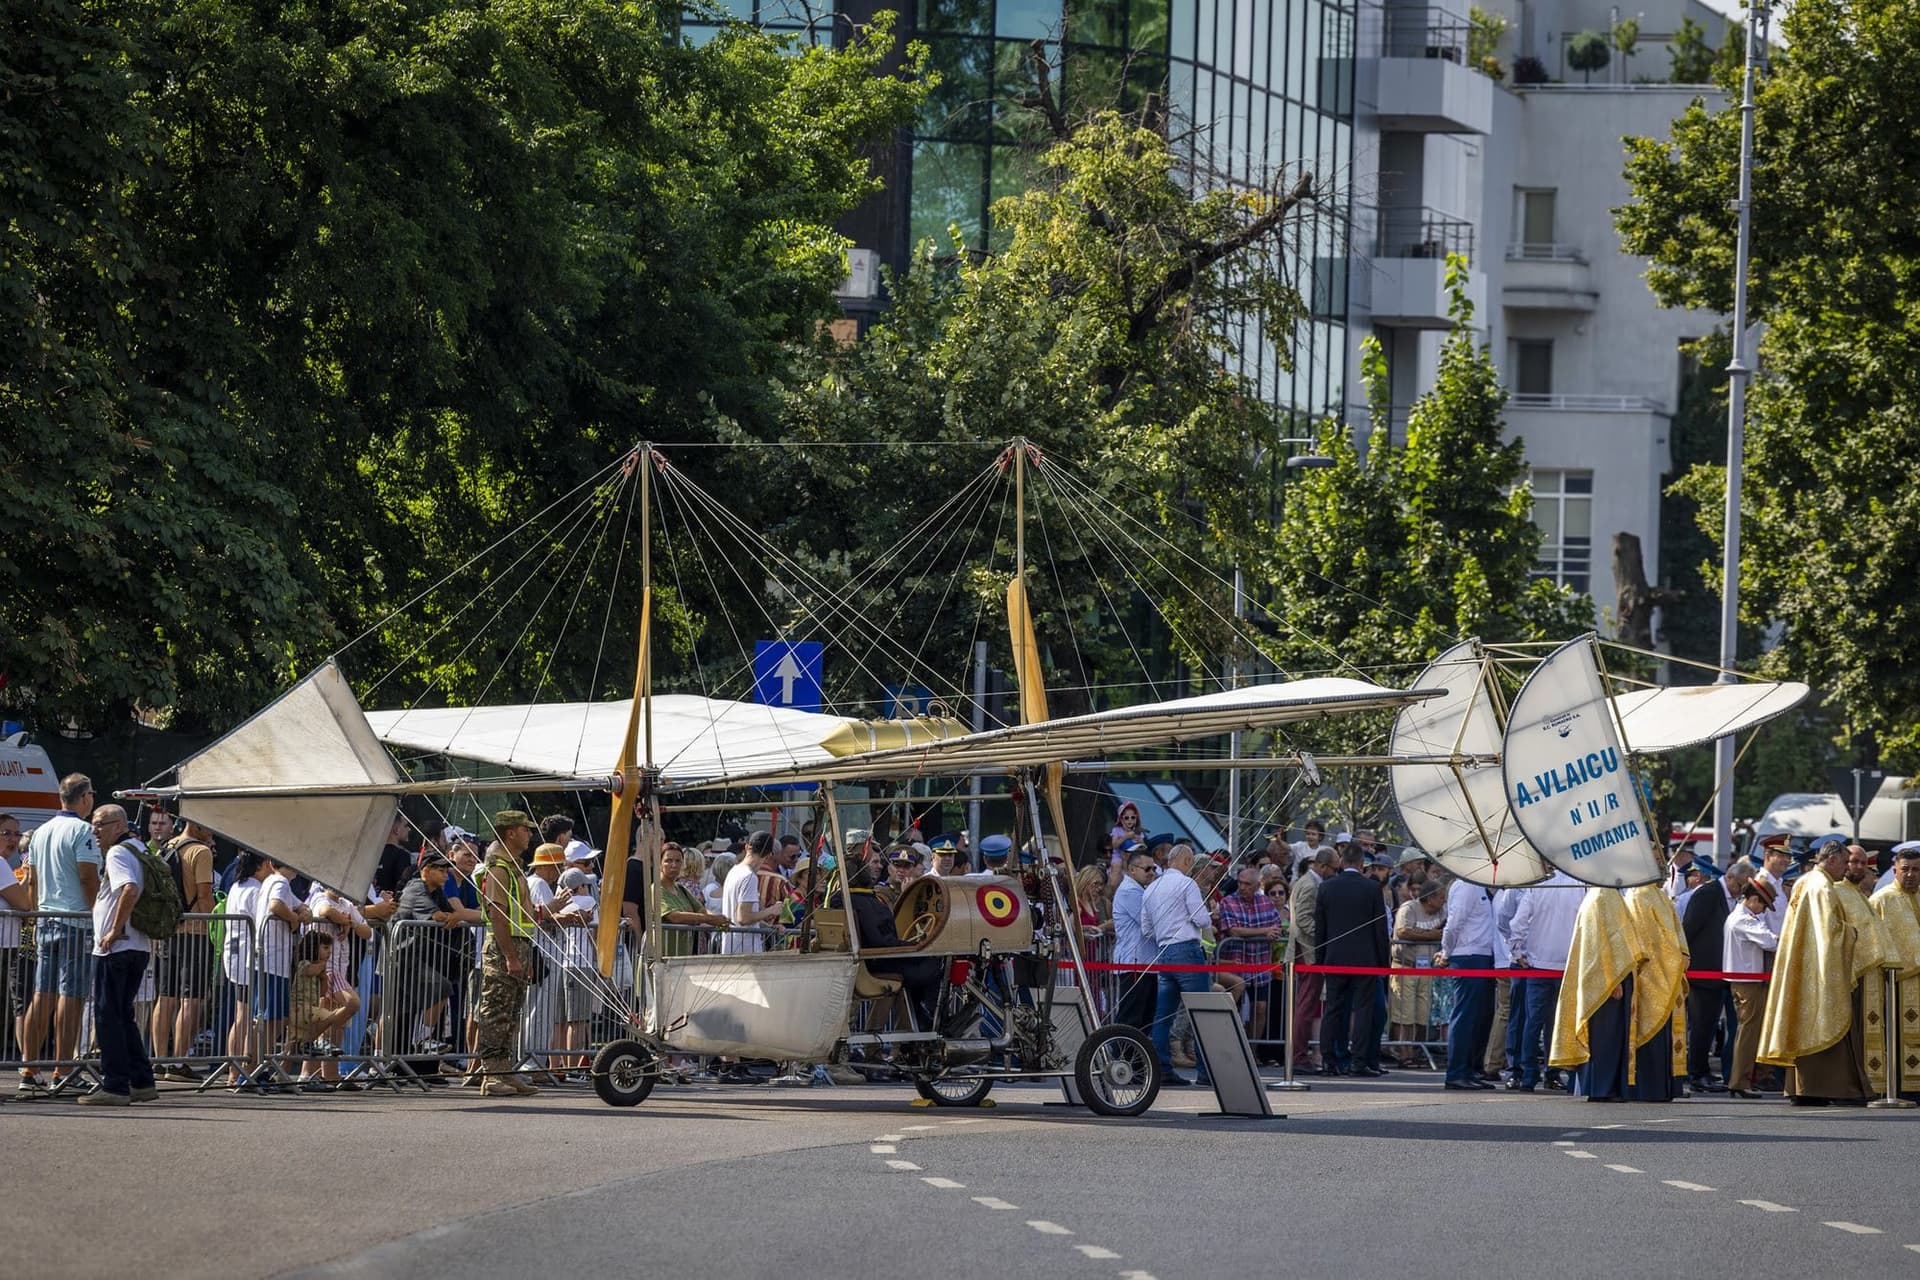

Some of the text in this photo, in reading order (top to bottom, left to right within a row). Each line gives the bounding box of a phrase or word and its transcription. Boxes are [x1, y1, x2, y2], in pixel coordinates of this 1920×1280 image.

[1517, 746, 1618, 808] A.VLAICU
[85, 838, 92, 850] 4
[1570, 820, 1639, 860] ROMANIA
